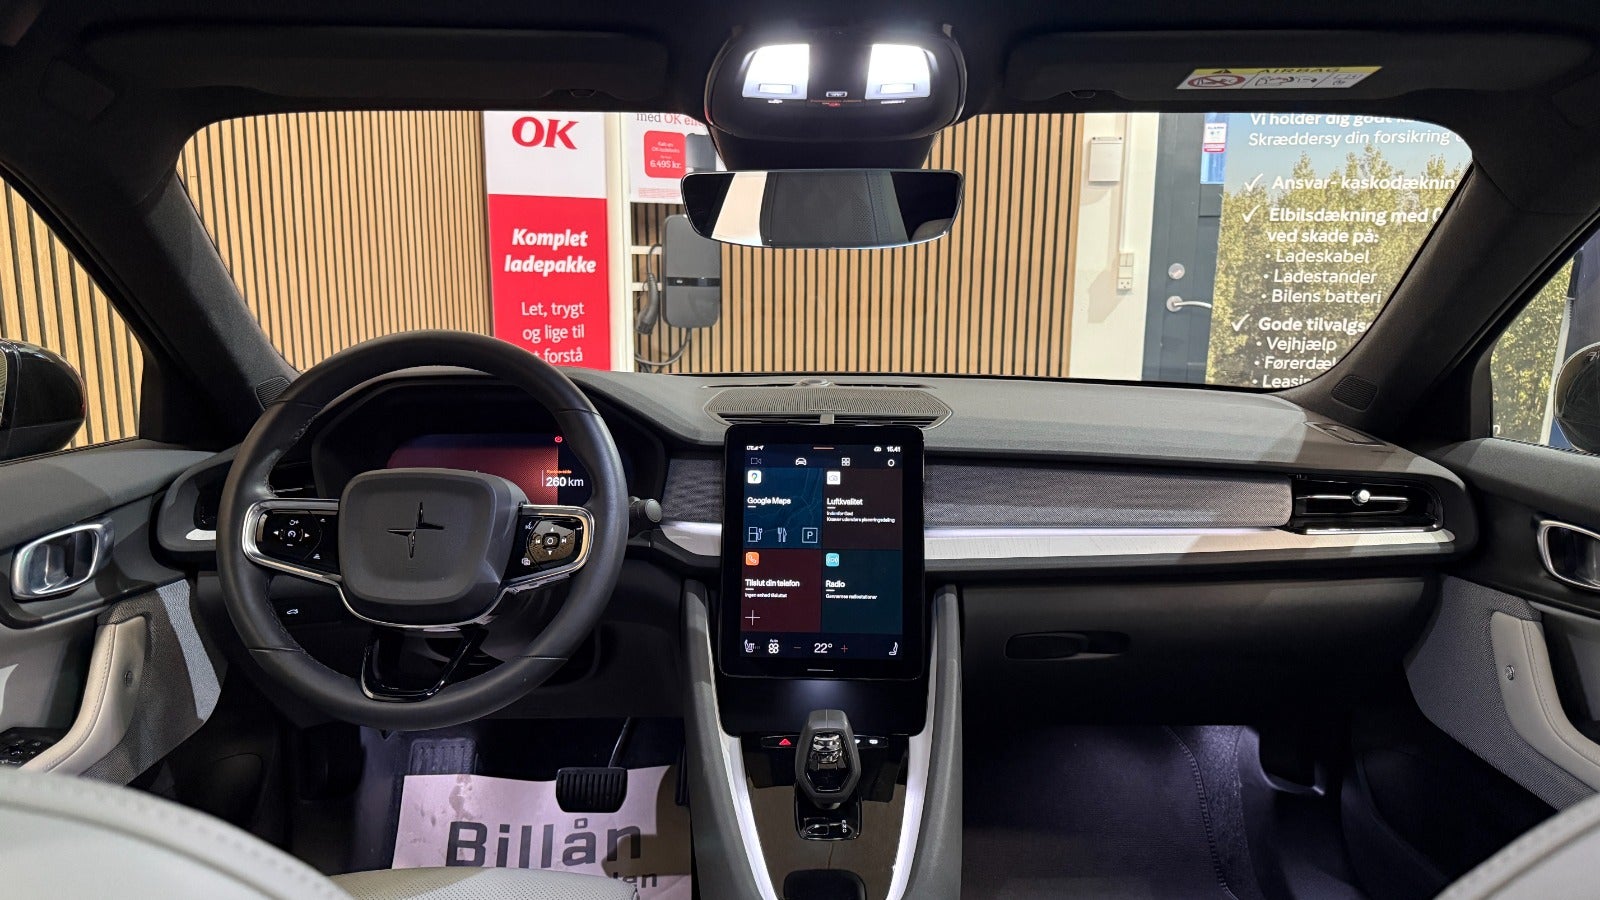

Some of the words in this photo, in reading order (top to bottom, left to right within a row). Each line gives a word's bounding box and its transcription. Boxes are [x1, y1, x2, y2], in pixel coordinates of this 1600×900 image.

[1251, 113, 1266, 126] Vi
[1269, 113, 1320, 126] holder
[512, 116, 579, 150] OK
[1249, 133, 1342, 148] Skræddersy
[1345, 131, 1370, 145] din
[1374, 130, 1451, 146] forsikring
[650, 159, 671, 169] 6.495
[672, 160, 682, 169] kr.
[1272, 176, 1337, 190] Ansvar-
[1341, 176, 1456, 191] kaskodæknin
[1269, 207, 1388, 225] Elbilsdækning
[1391, 209, 1426, 223] med
[512, 228, 588, 251] Komplet
[1268, 230, 1298, 243] ved
[1301, 230, 1349, 243] skade
[1353, 230, 1380, 246] på:
[1276, 249, 1370, 263] Ladeskabel
[504, 254, 597, 277] ladepakke
[1273, 269, 1378, 284] Ladestander
[1272, 289, 1321, 303] Bilens
[1325, 289, 1382, 304] batteri
[521, 301, 548, 319] Let,
[551, 301, 585, 319] trygt
[1258, 317, 1303, 332] Gode
[522, 327, 541, 343] og
[544, 324, 569, 343] lige
[572, 324, 585, 339] til
[1267, 337, 1338, 353] Vejhjælp
[543, 346, 583, 363] forstå
[546, 476, 567, 487] 260
[568, 476, 584, 487] km
[747, 497, 771, 506] Google
[772, 497, 791, 505] Maps
[826, 498, 863, 506] Luftkvalitet
[745, 578, 765, 588] Tilslut
[766, 579, 776, 587] din
[777, 579, 800, 588] telefon
[825, 580, 846, 588] Radio
[814, 642, 833, 654] 22°
[445, 817, 642, 869] Billån
